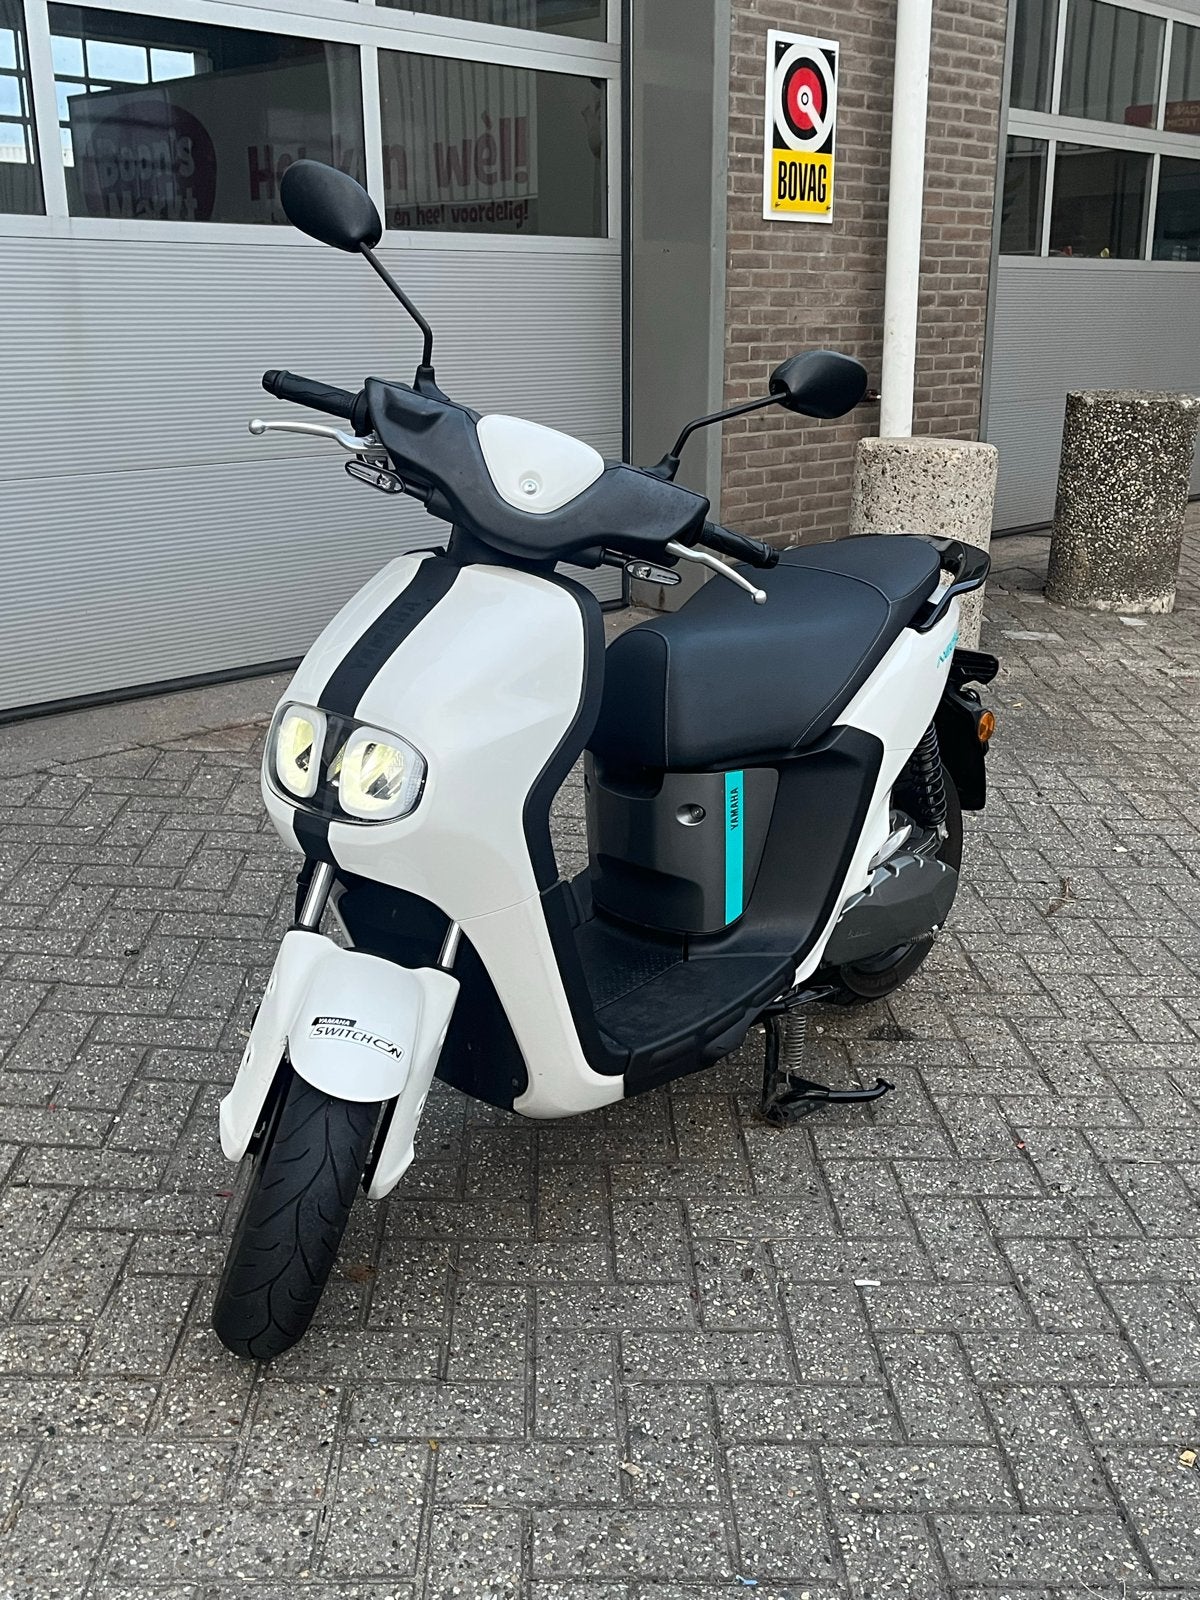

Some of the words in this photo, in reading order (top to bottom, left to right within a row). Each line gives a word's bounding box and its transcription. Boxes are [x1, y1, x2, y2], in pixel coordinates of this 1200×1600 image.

[778, 161, 827, 202] BOVAG
[416, 203, 445, 226] heel
[450, 198, 529, 230] voordelig!
[730, 787, 739, 831] YAMAHA
[313, 1026, 373, 1044] SWITCH
[318, 1017, 352, 1026] YAMAHA
